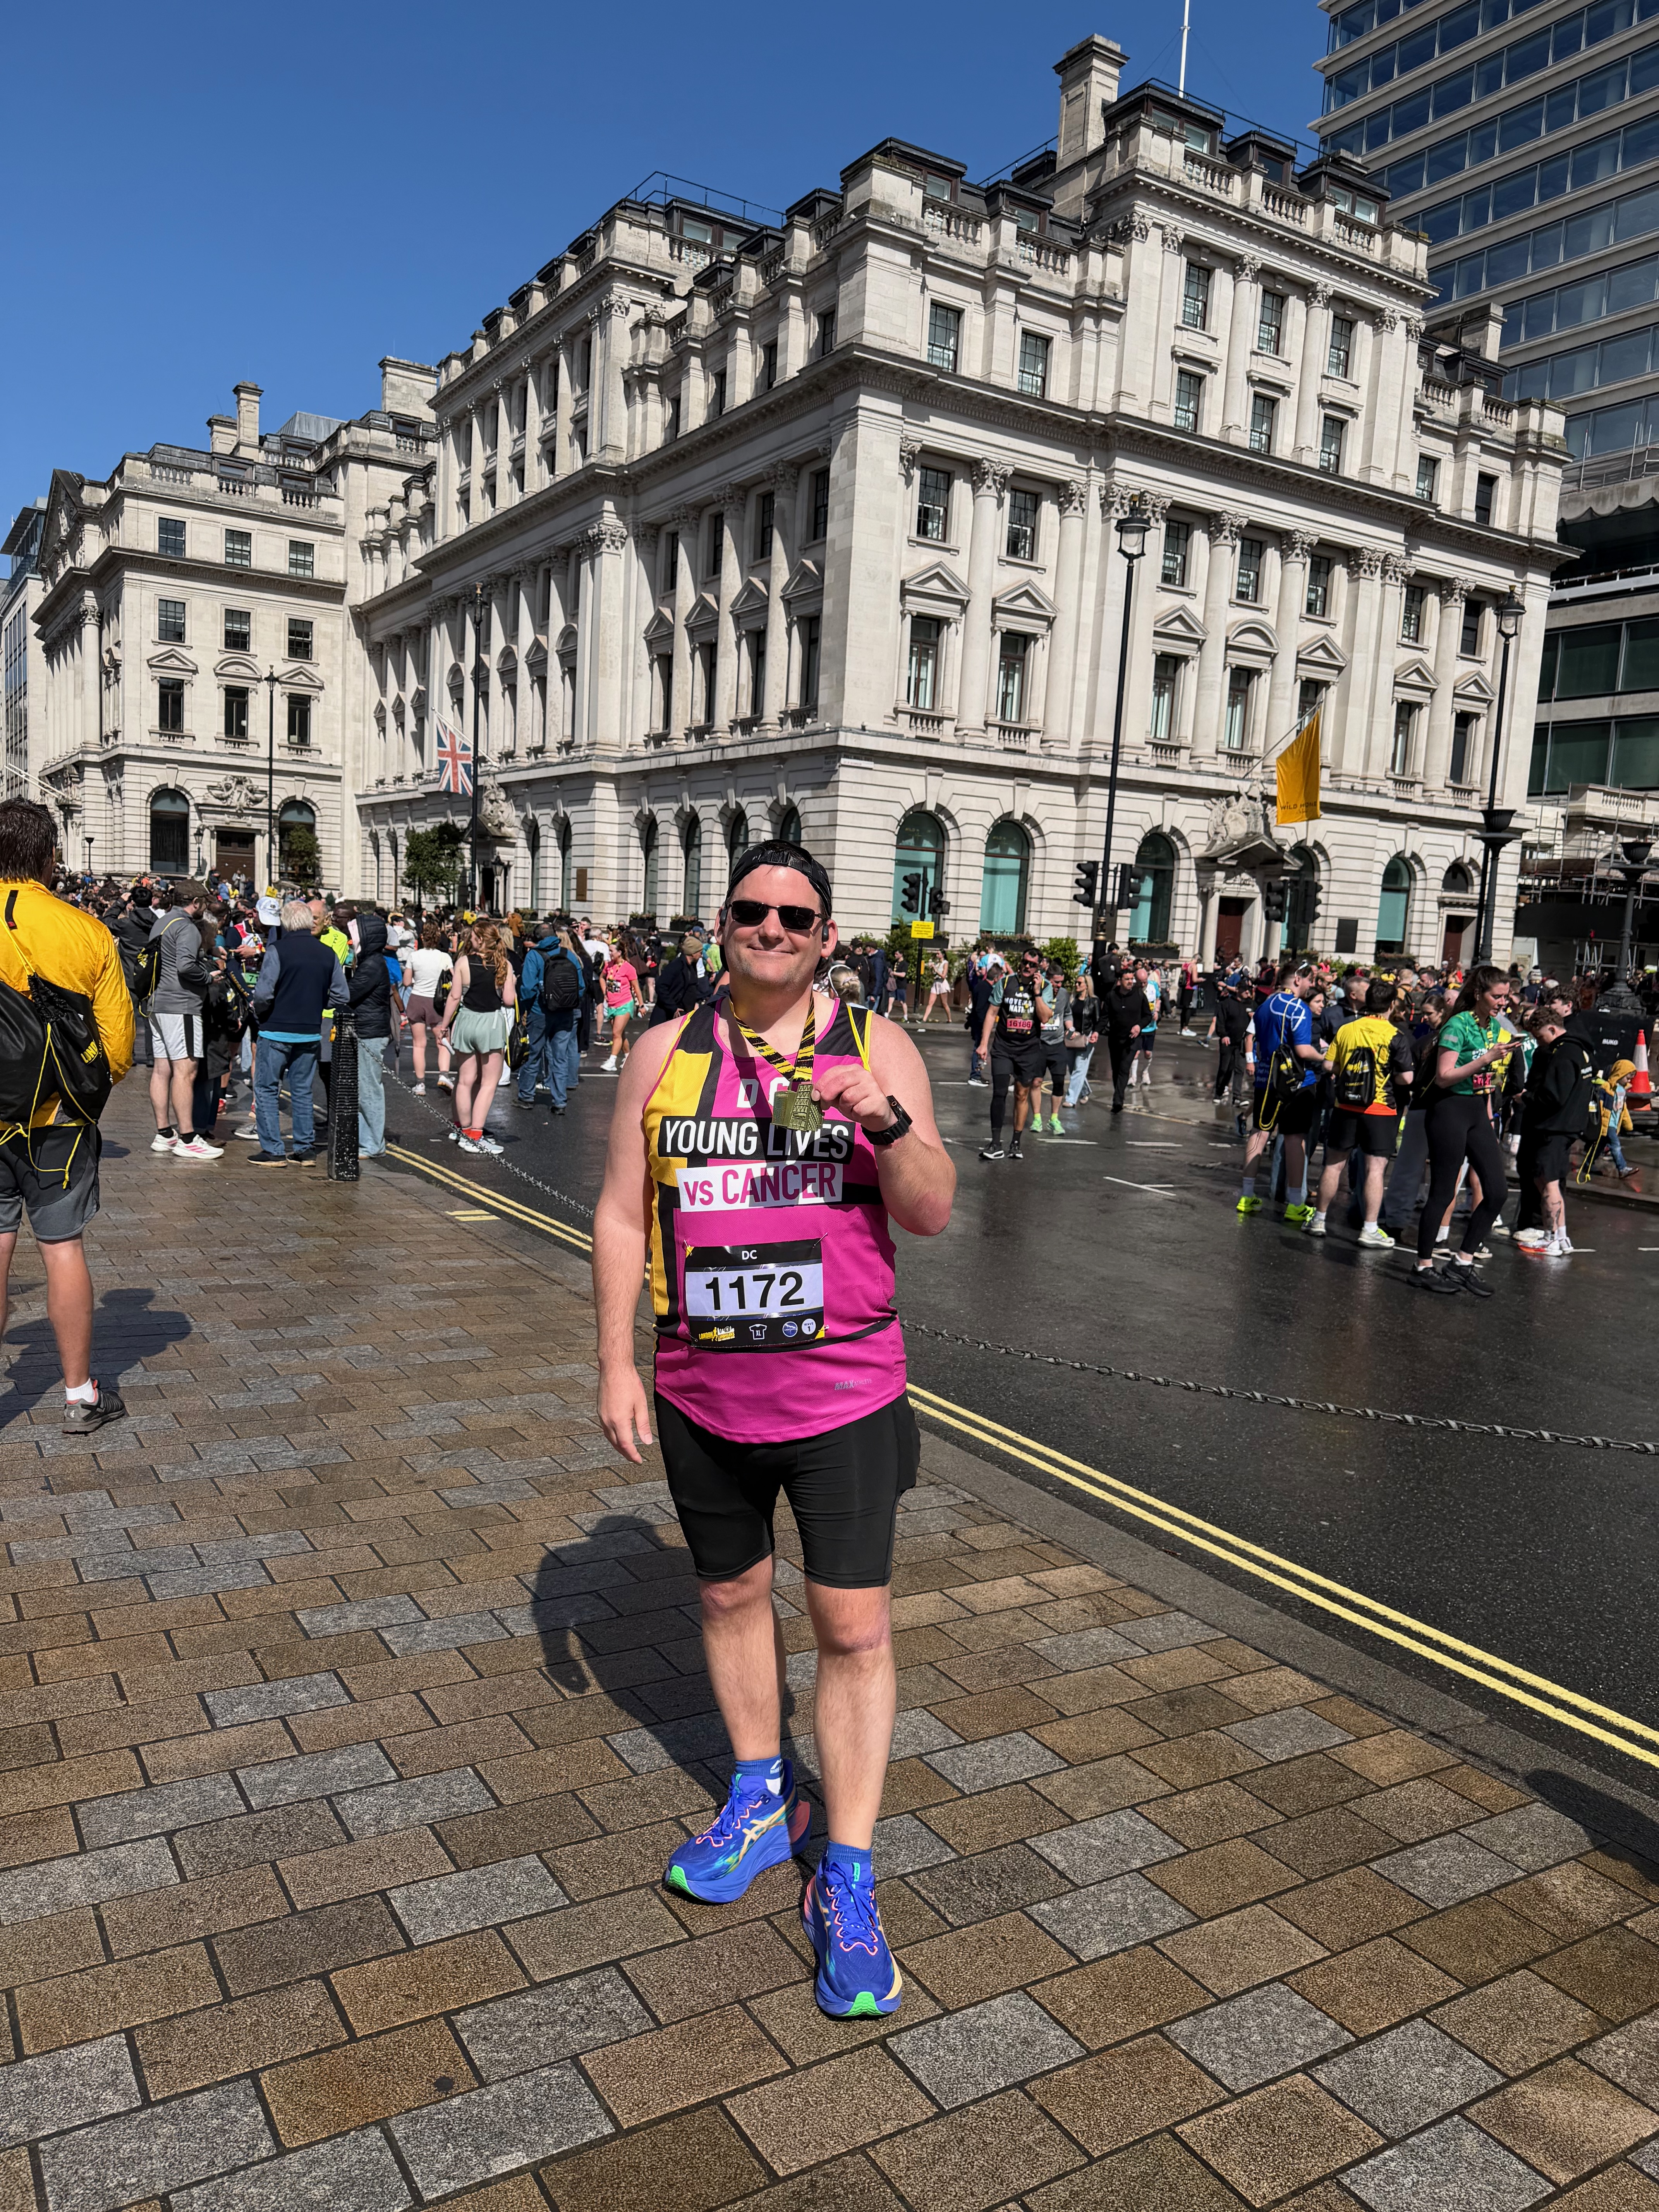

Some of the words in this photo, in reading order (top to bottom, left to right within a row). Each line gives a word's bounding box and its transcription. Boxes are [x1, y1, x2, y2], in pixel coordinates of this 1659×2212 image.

[666, 1120, 759, 1155] YOUNG
[767, 1123, 849, 1159] LIVES
[722, 1163, 836, 1204] CANCER
[742, 1250, 757, 1260] DC
[706, 1271, 804, 1310] 1172
[699, 1331, 713, 1340] LONDON
